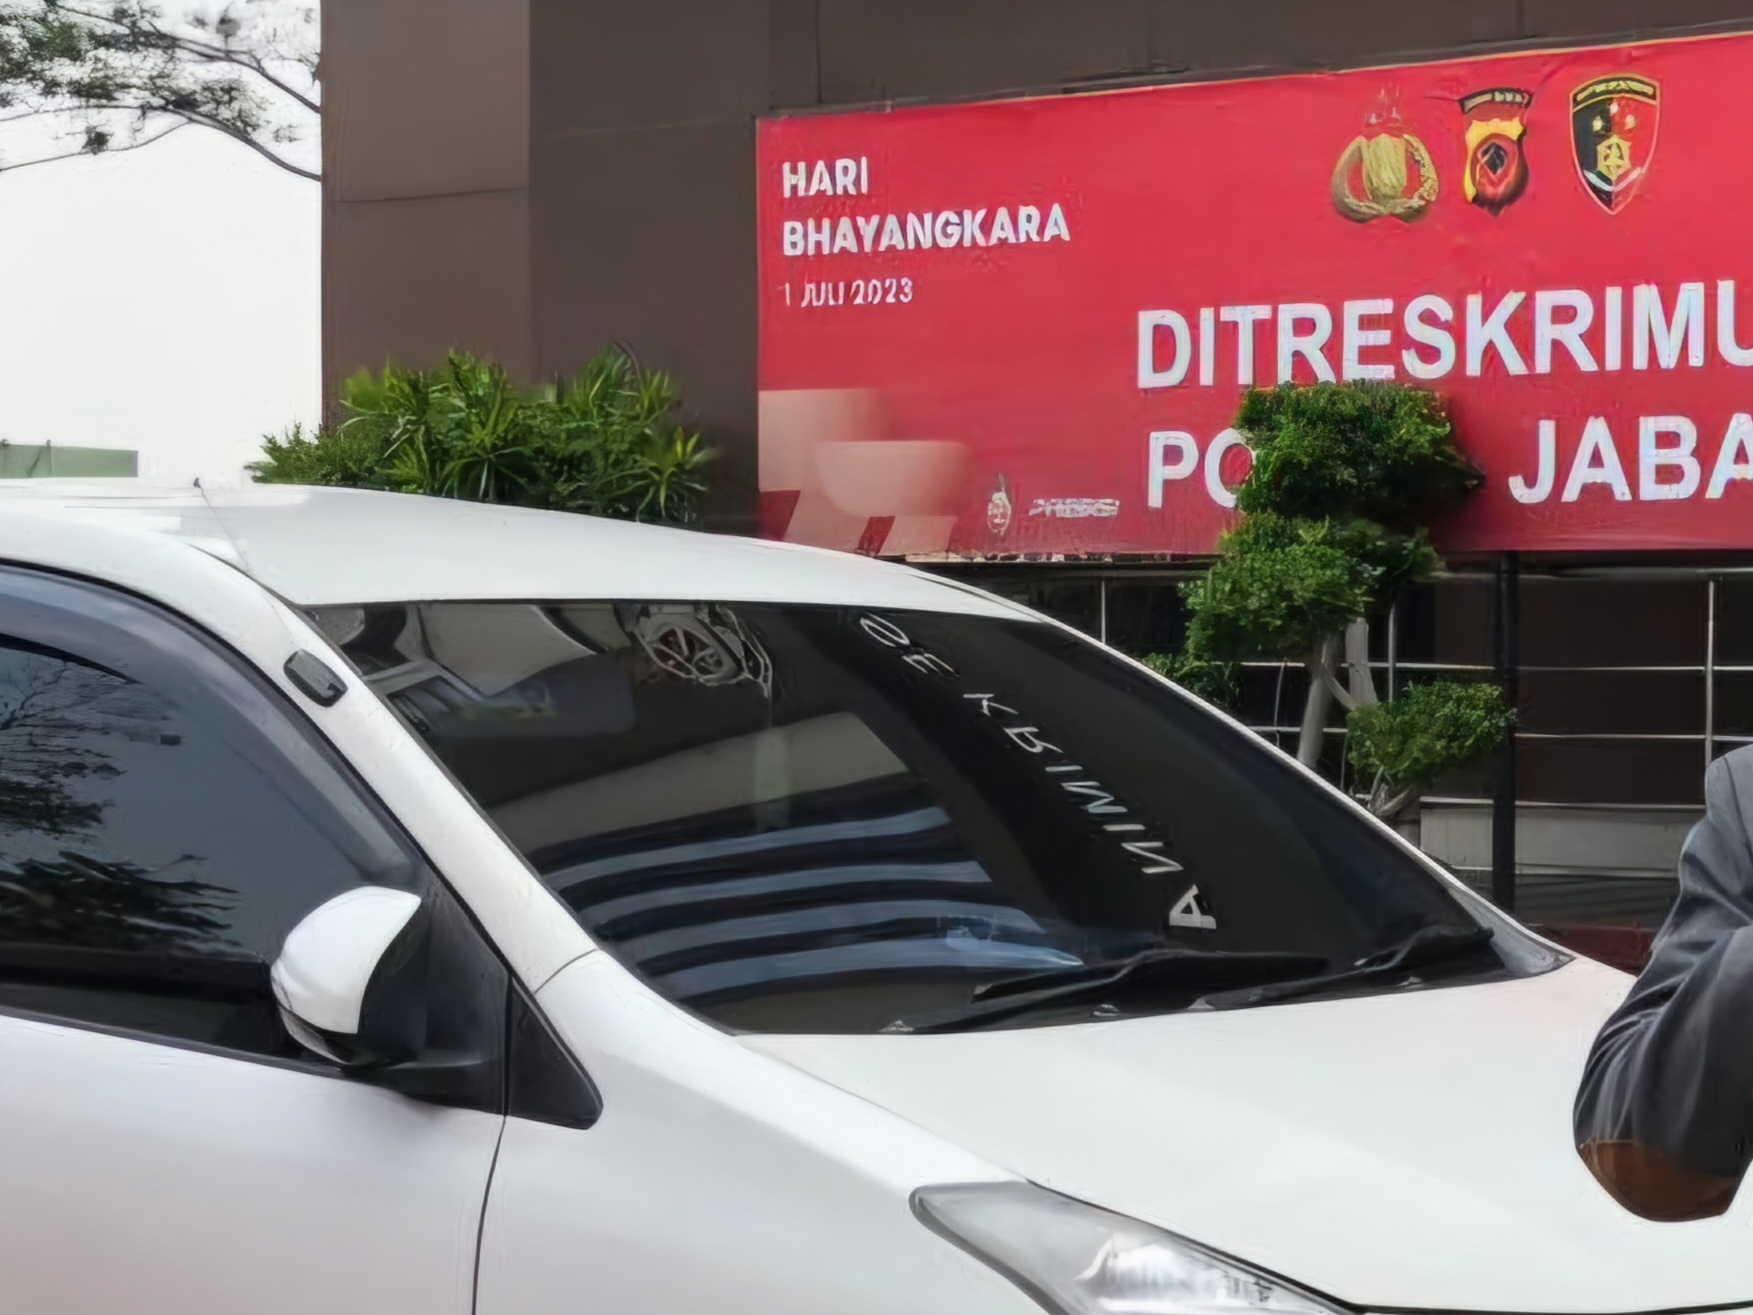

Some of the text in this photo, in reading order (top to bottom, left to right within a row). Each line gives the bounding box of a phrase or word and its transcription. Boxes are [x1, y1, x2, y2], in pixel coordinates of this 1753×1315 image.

[782, 156, 868, 198] HARI
[783, 203, 1071, 256] BHAYANGKARA
[801, 281, 845, 307] JULI
[850, 276, 914, 305] 2023
